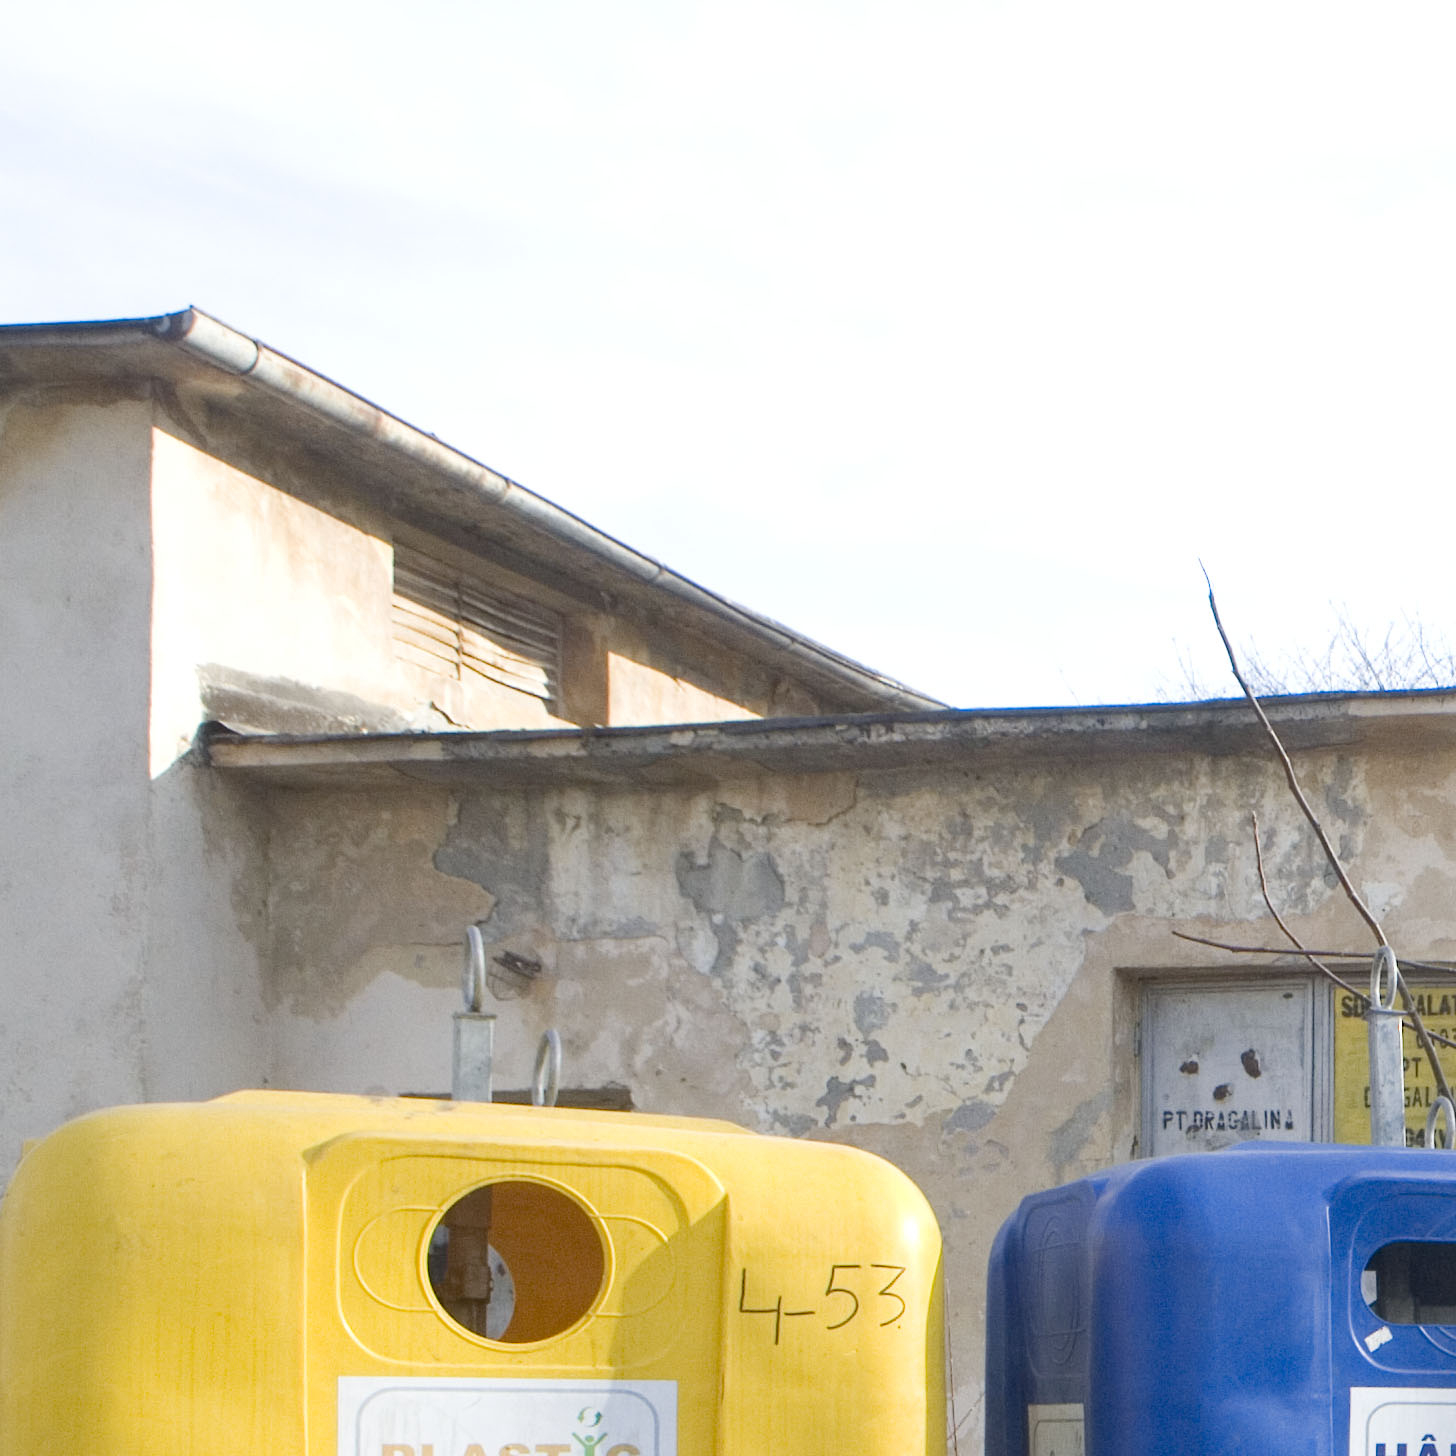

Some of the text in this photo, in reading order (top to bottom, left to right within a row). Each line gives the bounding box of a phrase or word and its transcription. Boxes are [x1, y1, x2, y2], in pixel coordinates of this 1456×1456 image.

[1162, 1110, 1294, 1131] PT DRAGALINA
[738, 1264, 906, 1346] 4-53
